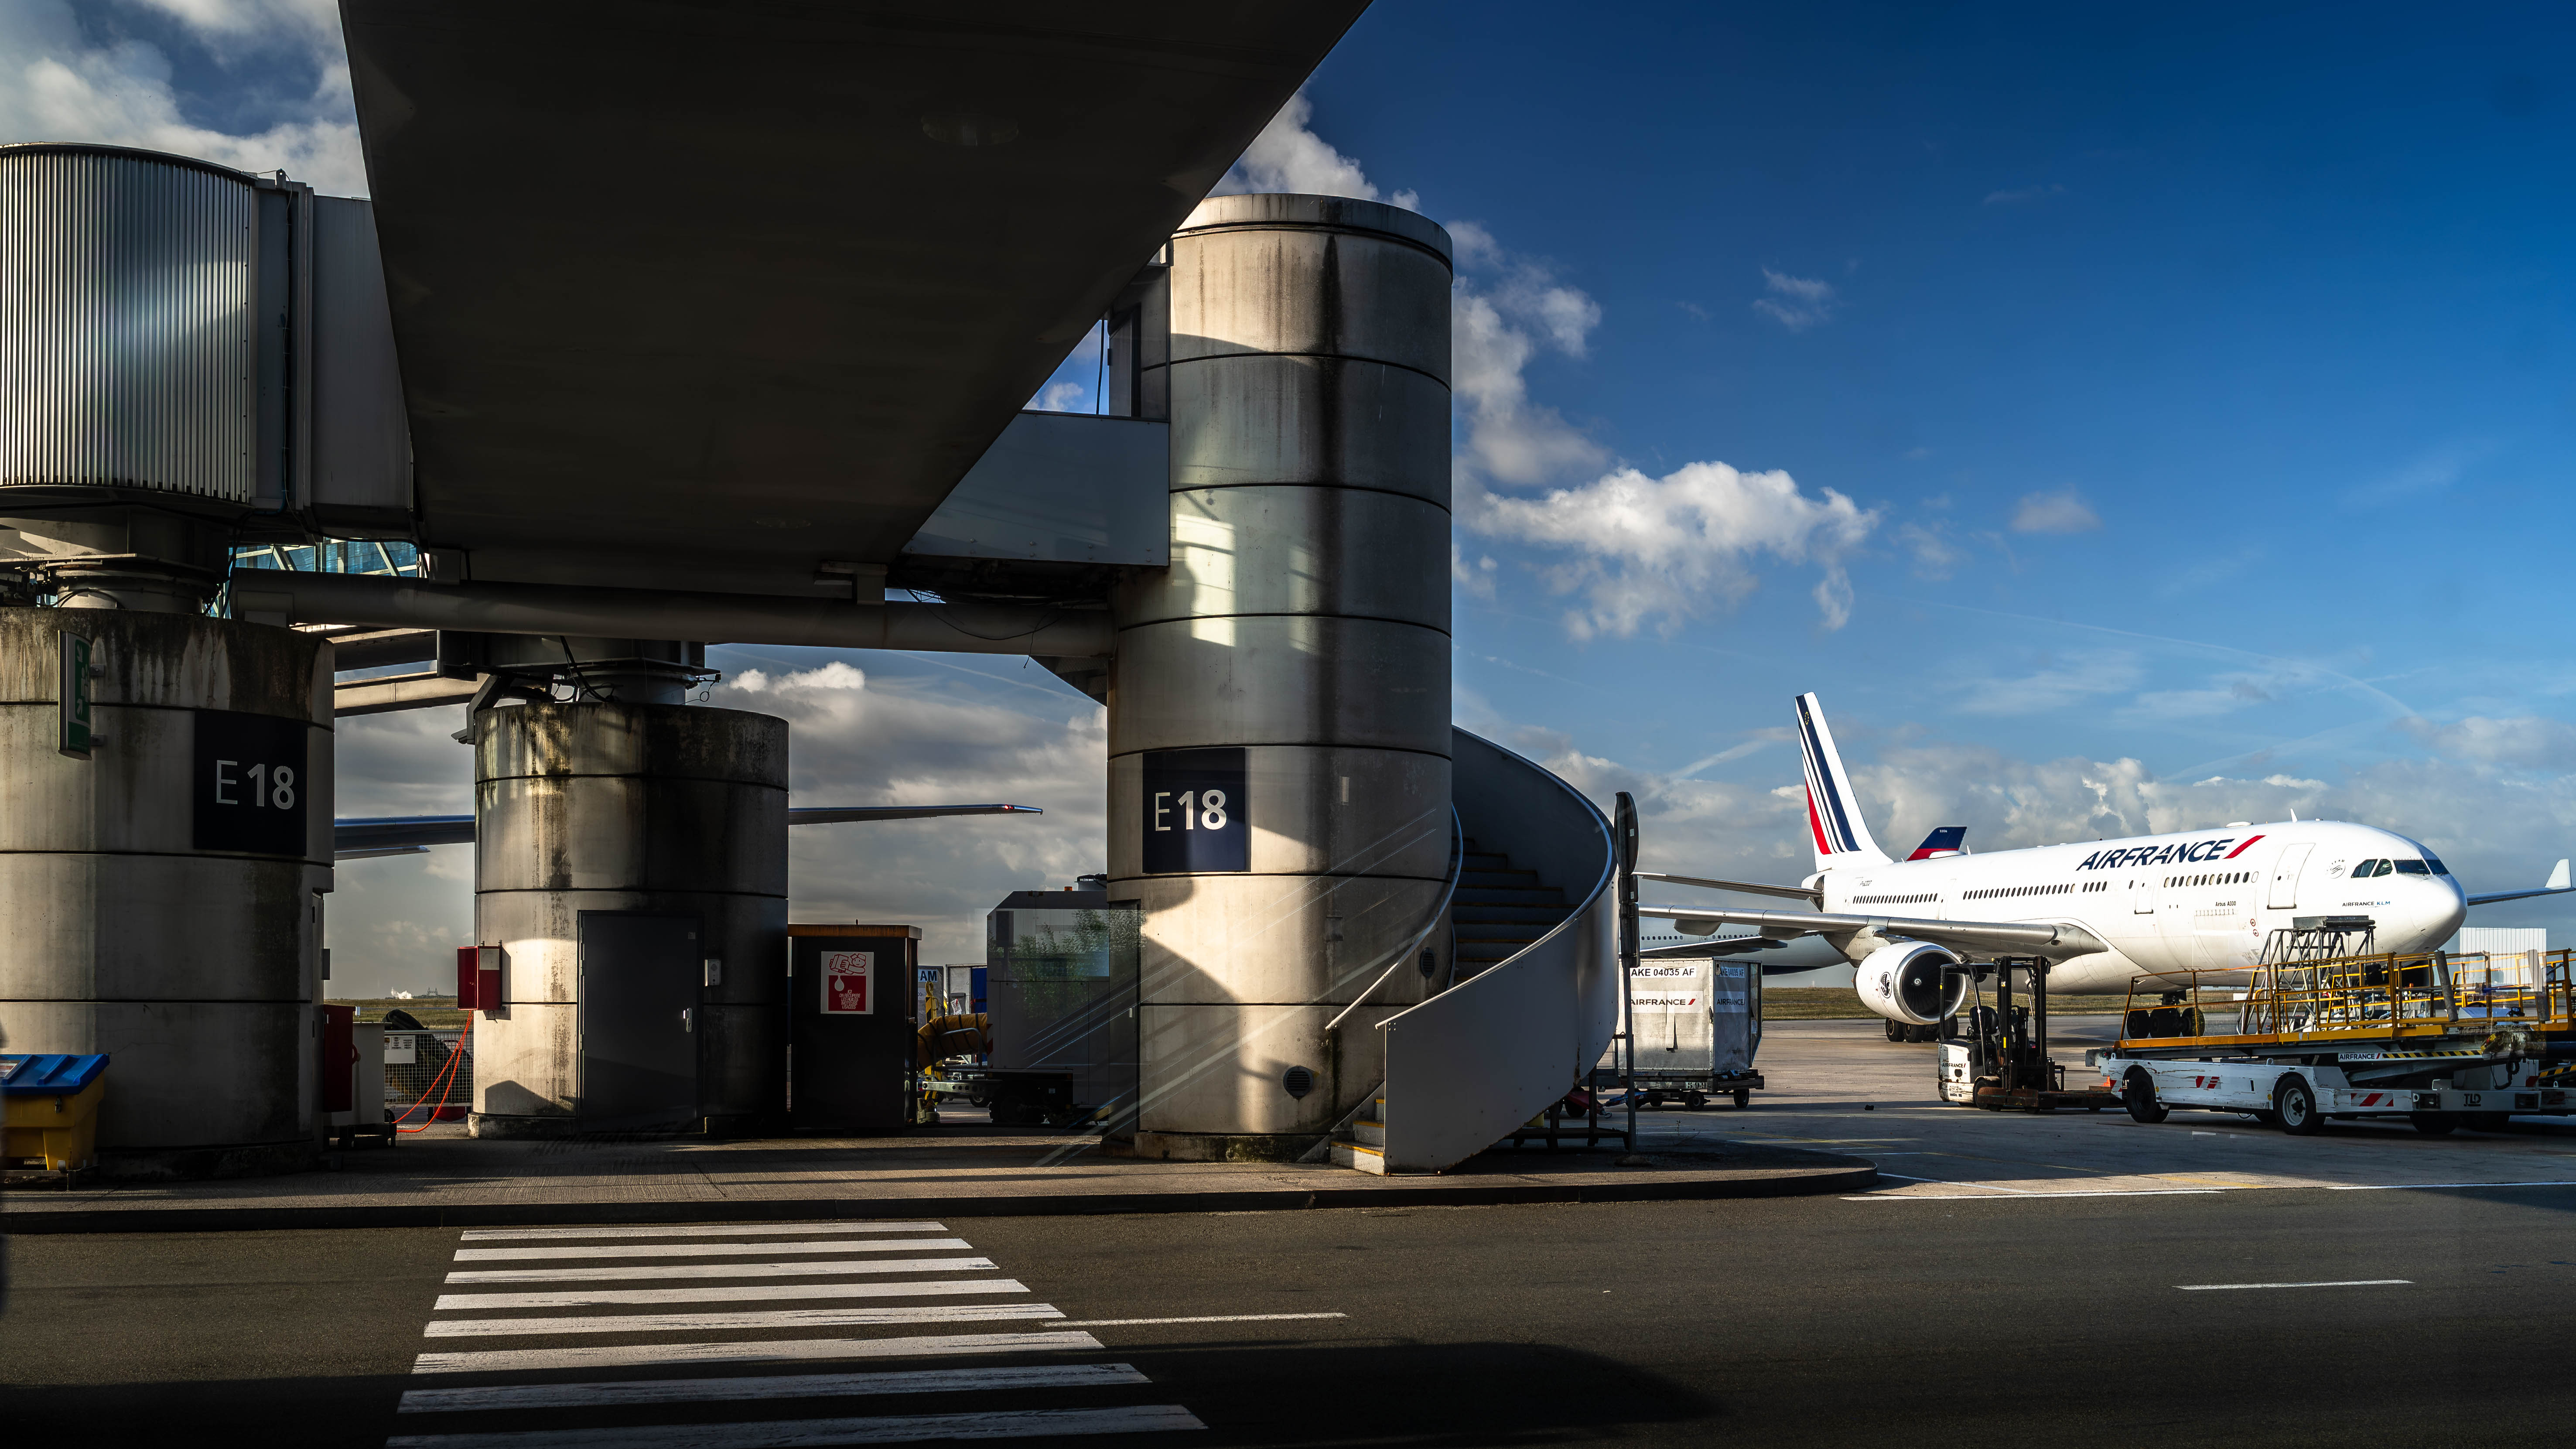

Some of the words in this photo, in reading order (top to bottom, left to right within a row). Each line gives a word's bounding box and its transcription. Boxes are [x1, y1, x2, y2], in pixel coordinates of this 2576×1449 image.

[216, 760, 294, 810] E18
[1155, 789, 1227, 831] E18
[2076, 838, 2235, 871] AIRFRANCE
[920, 971, 937, 981] AM
[1654, 968, 1679, 976] 04035
[2464, 1094, 2481, 1104] TLD
